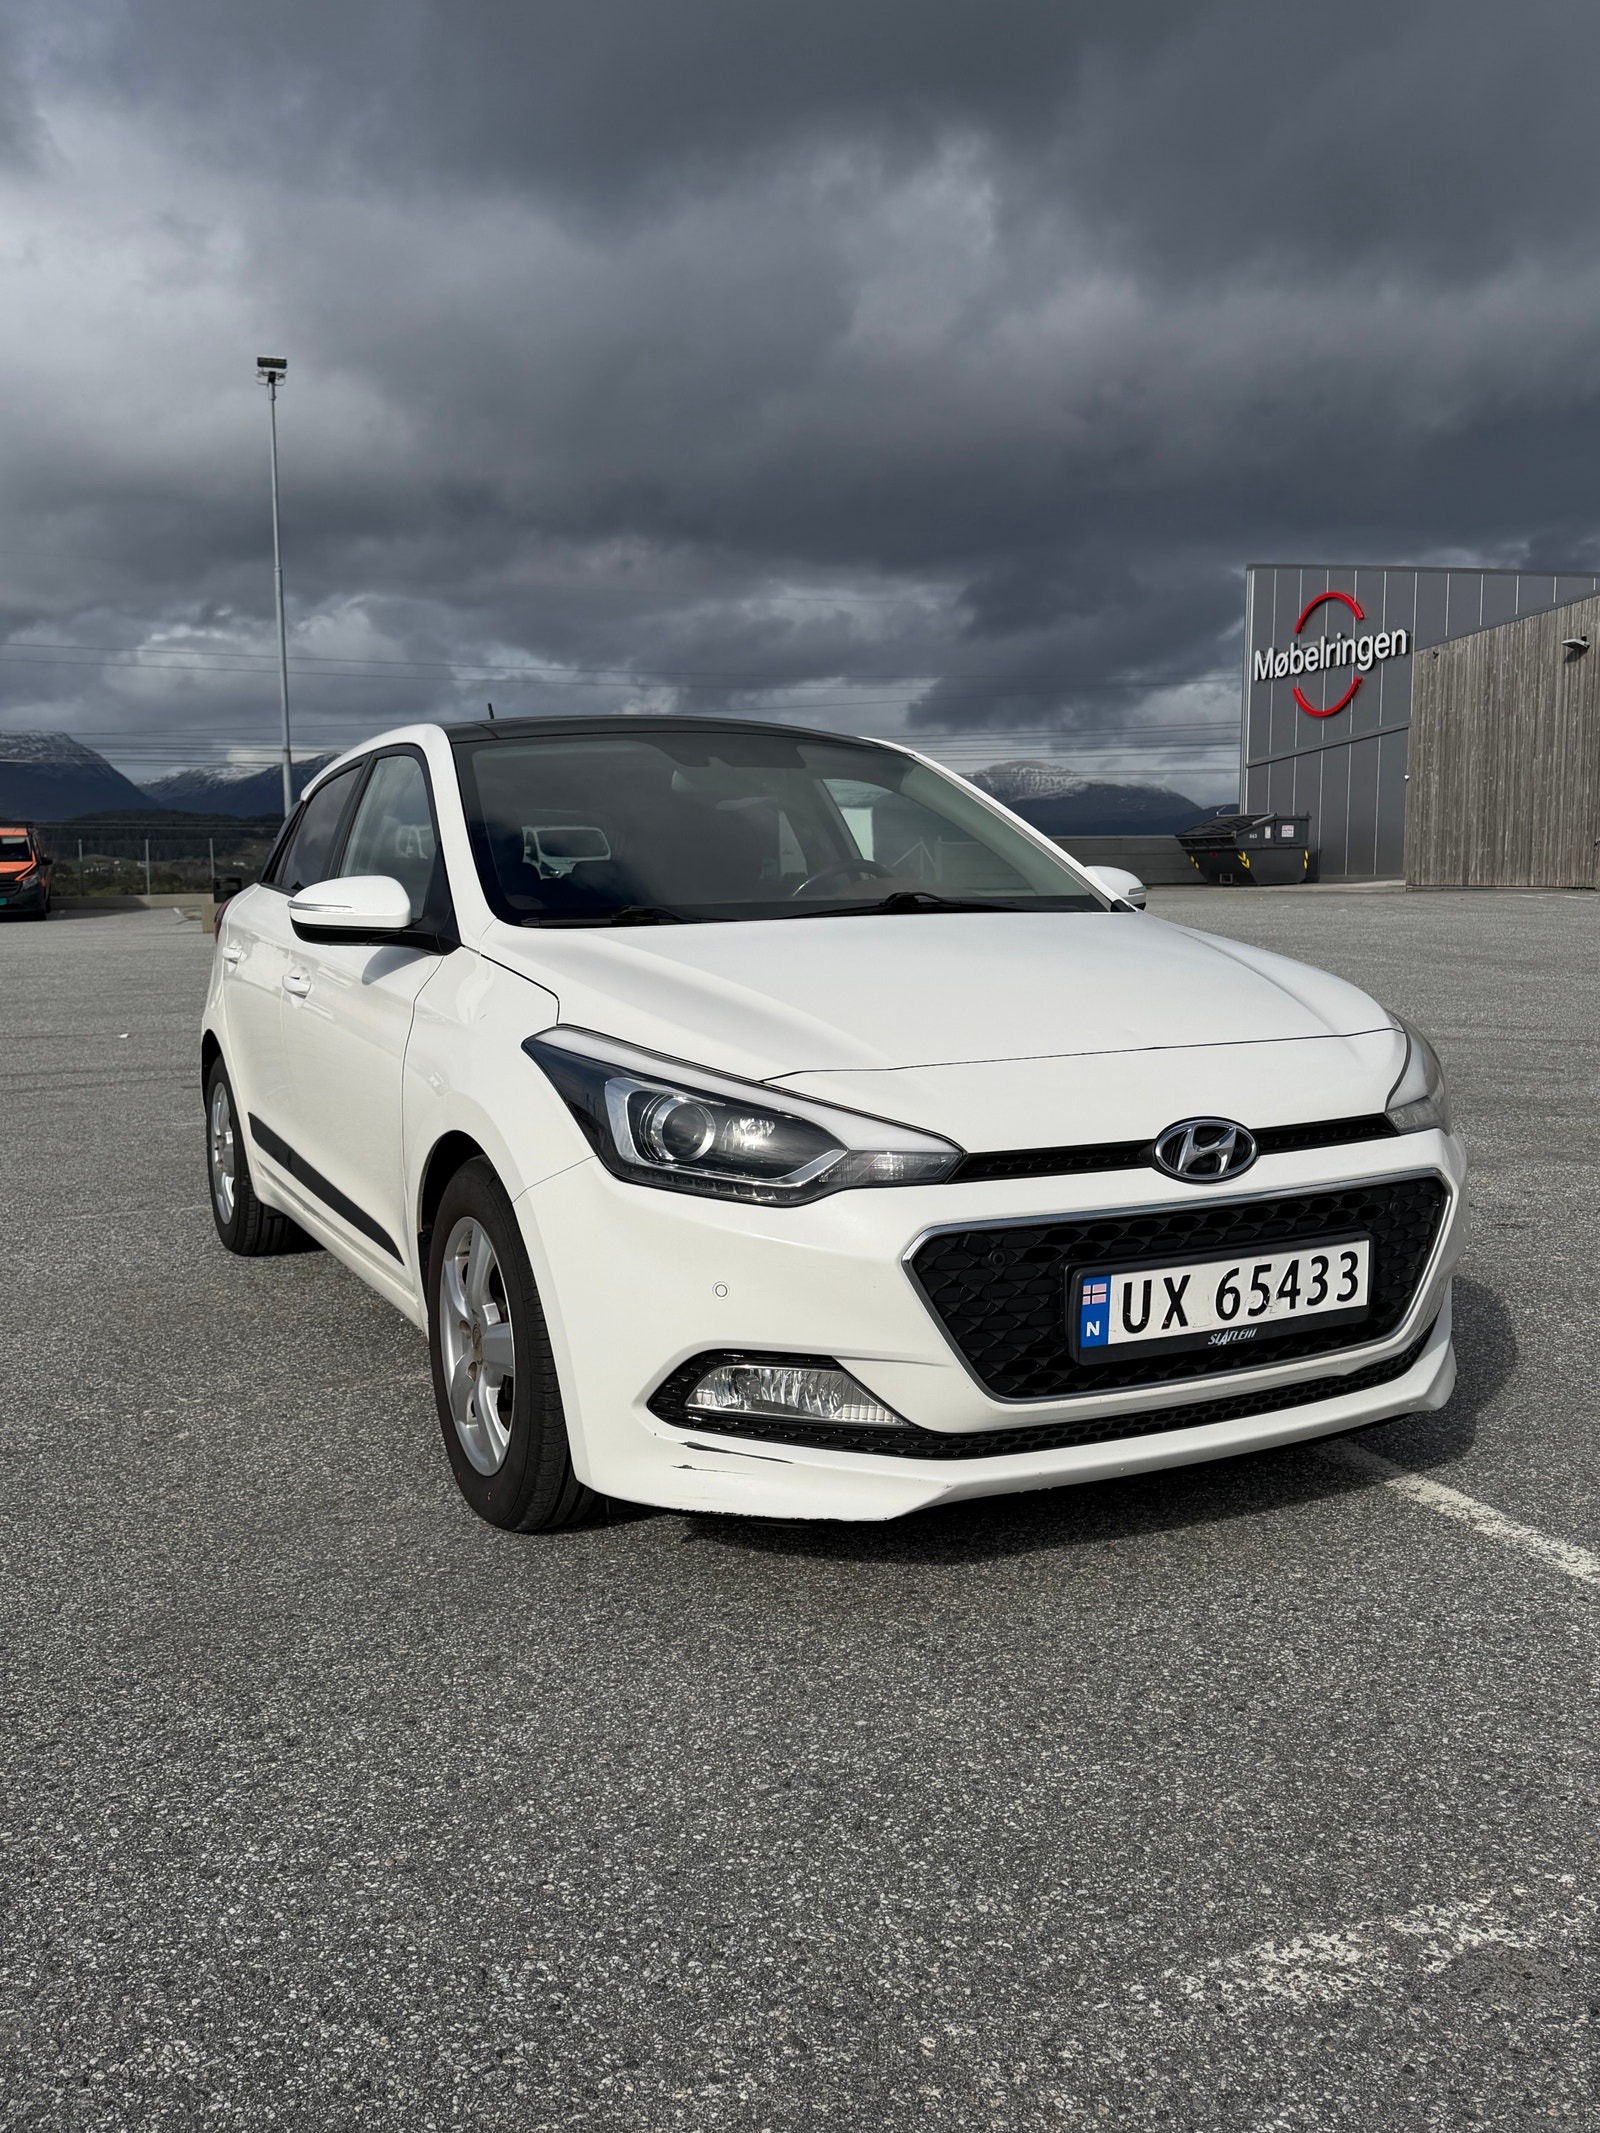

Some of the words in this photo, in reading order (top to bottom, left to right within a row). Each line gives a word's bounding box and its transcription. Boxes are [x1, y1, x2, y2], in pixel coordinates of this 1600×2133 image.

[1254, 629, 1407, 681] Møbelringen
[1121, 1274, 1191, 1334] UX
[1215, 1251, 1359, 1321] 65433
[1086, 1320, 1100, 1337] N
